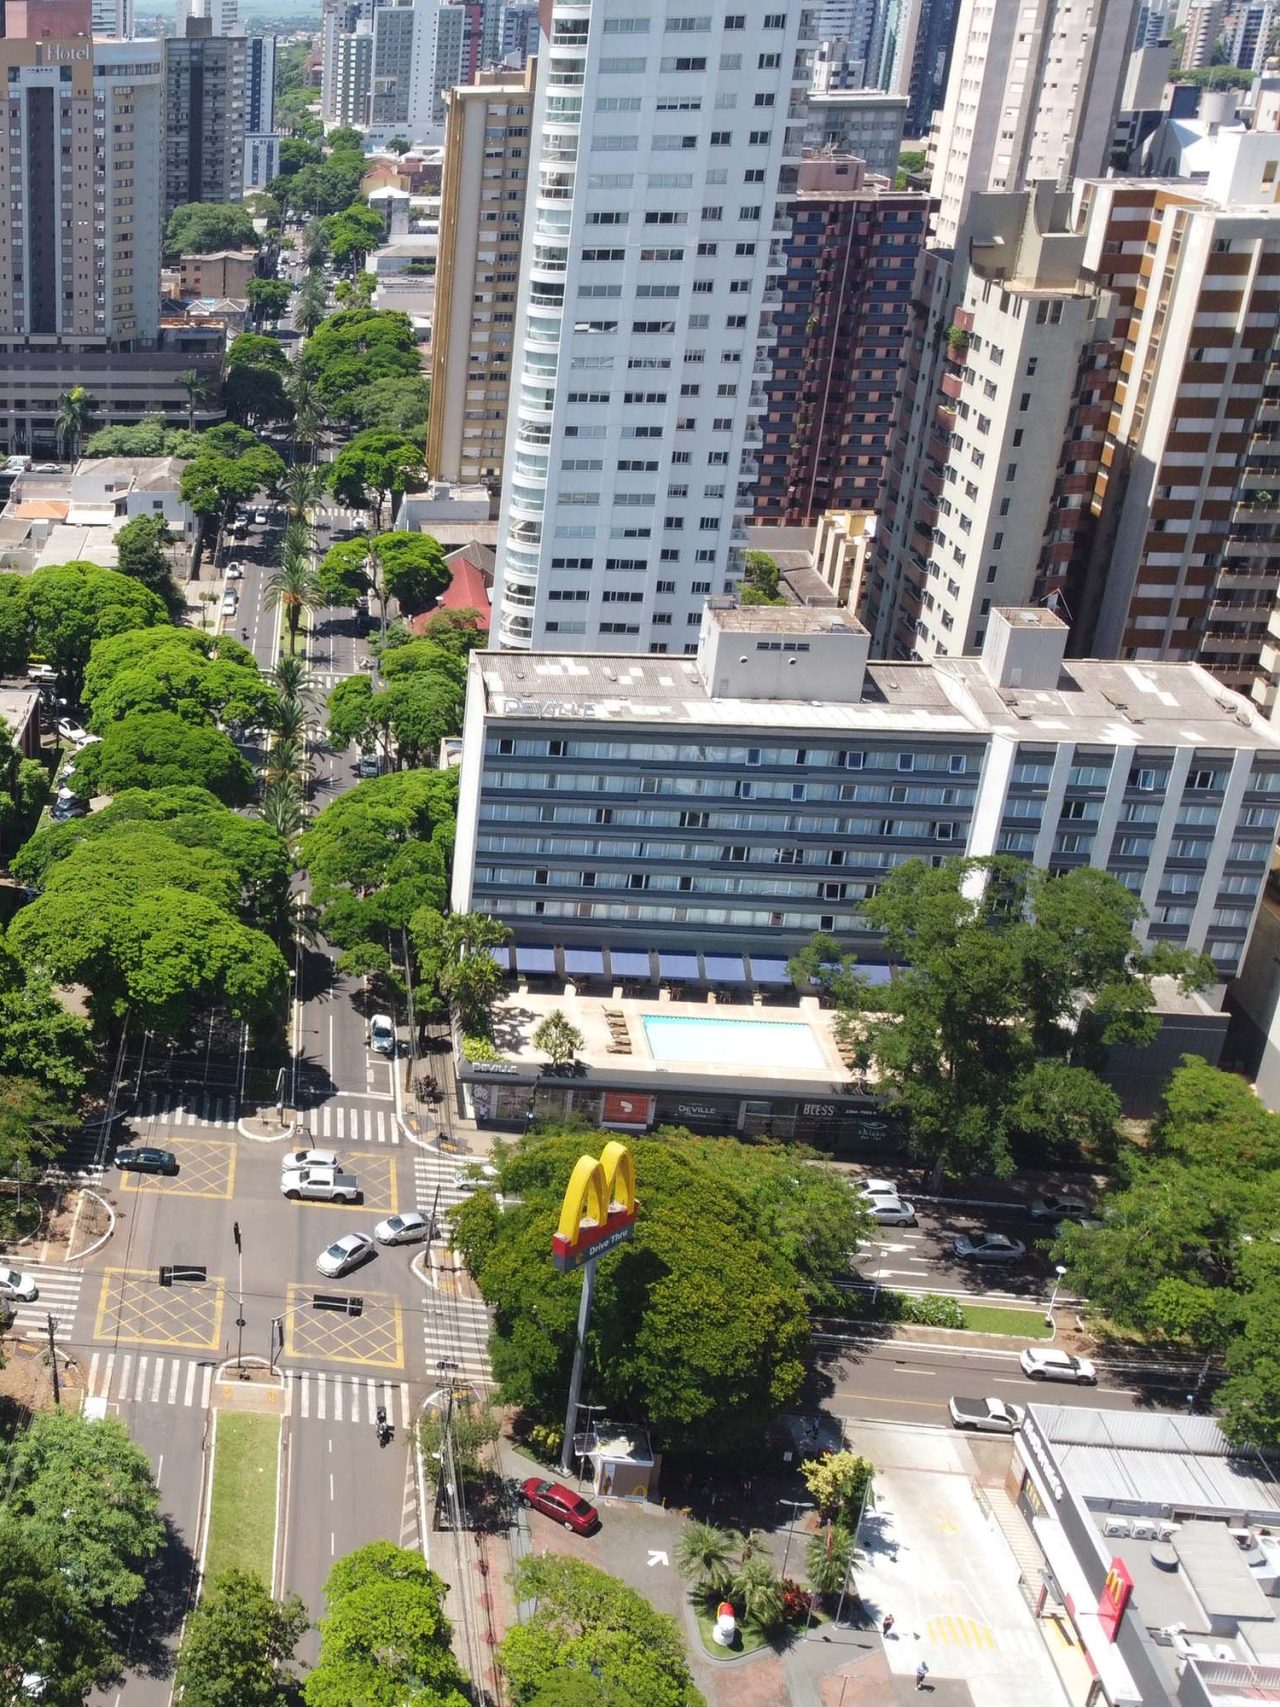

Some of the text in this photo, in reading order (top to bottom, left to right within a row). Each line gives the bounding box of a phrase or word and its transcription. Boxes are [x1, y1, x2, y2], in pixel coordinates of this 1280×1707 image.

[47, 44, 89, 60] Hotel
[503, 699, 597, 718] DEVILLE
[472, 1062, 518, 1073] DEVILLE
[678, 1104, 717, 1114] DEVILLE
[589, 1228, 628, 1256] Drive Thru
